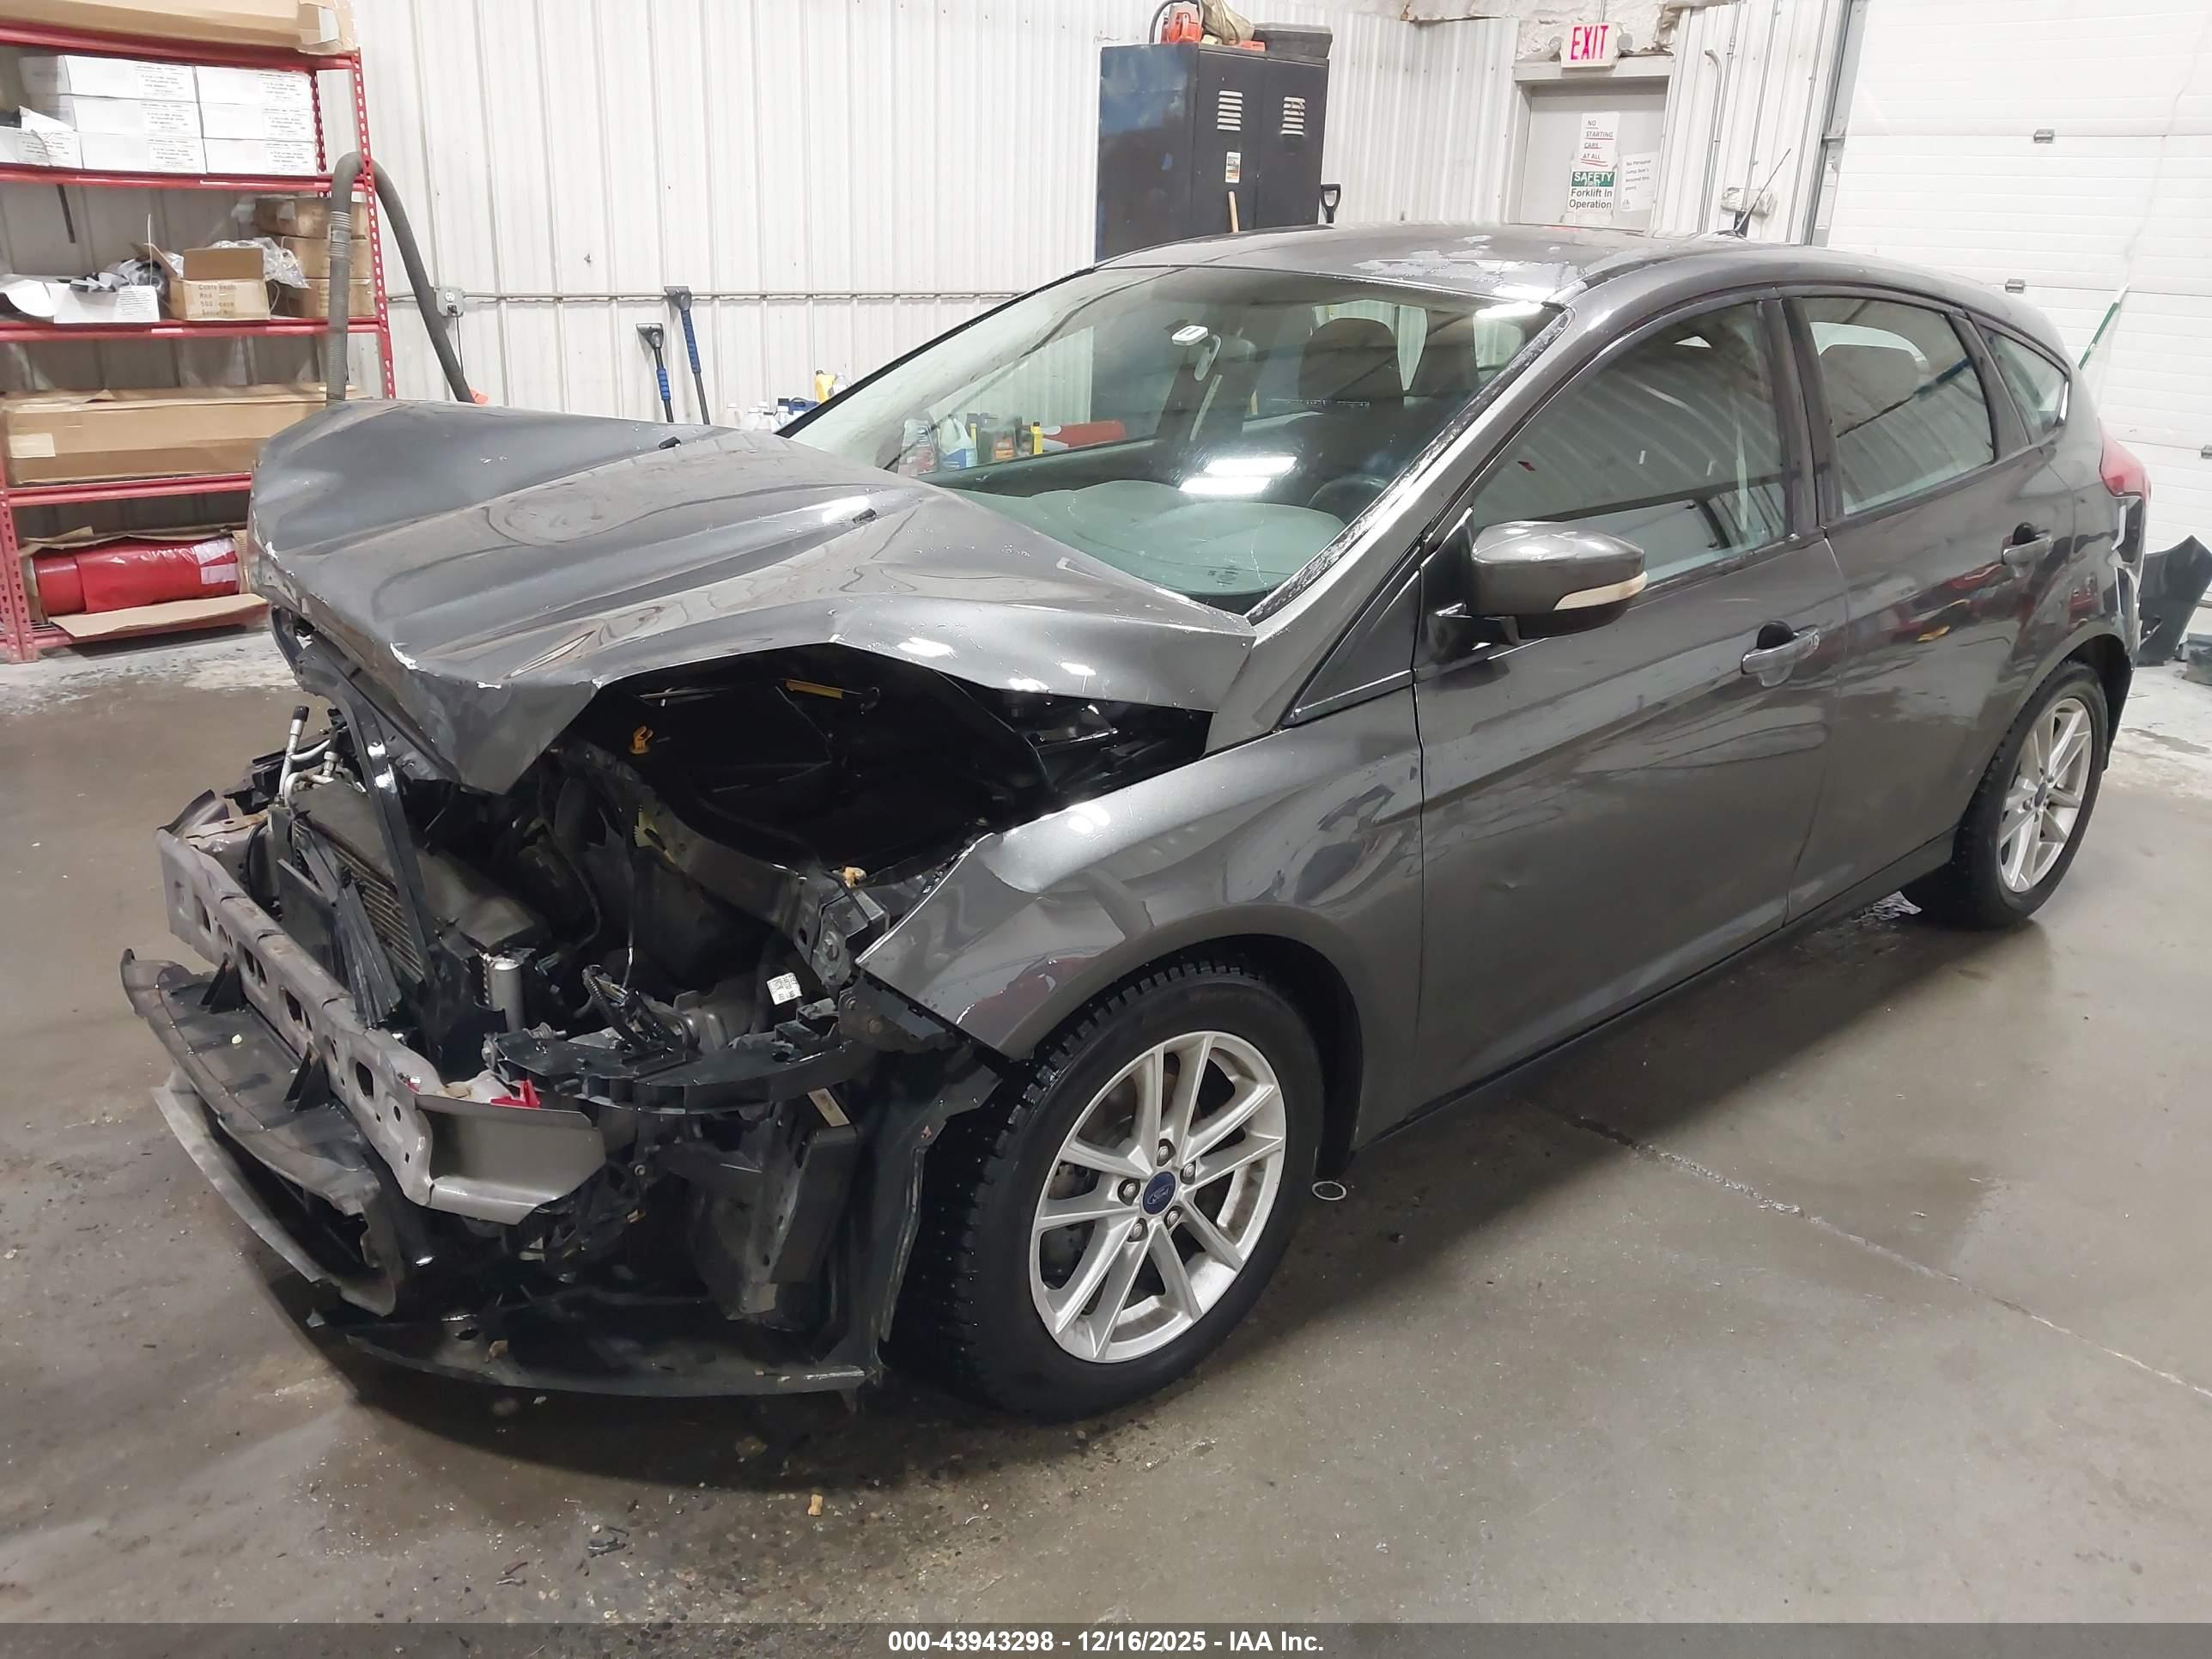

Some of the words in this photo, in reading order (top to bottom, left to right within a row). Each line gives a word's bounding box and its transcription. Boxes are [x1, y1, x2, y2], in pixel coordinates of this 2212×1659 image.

[1571, 26, 1608, 60] EXIT
[1574, 172, 1613, 182] SAFETY
[1571, 188, 1602, 198] Forklift
[1569, 198, 1612, 210] Operation
